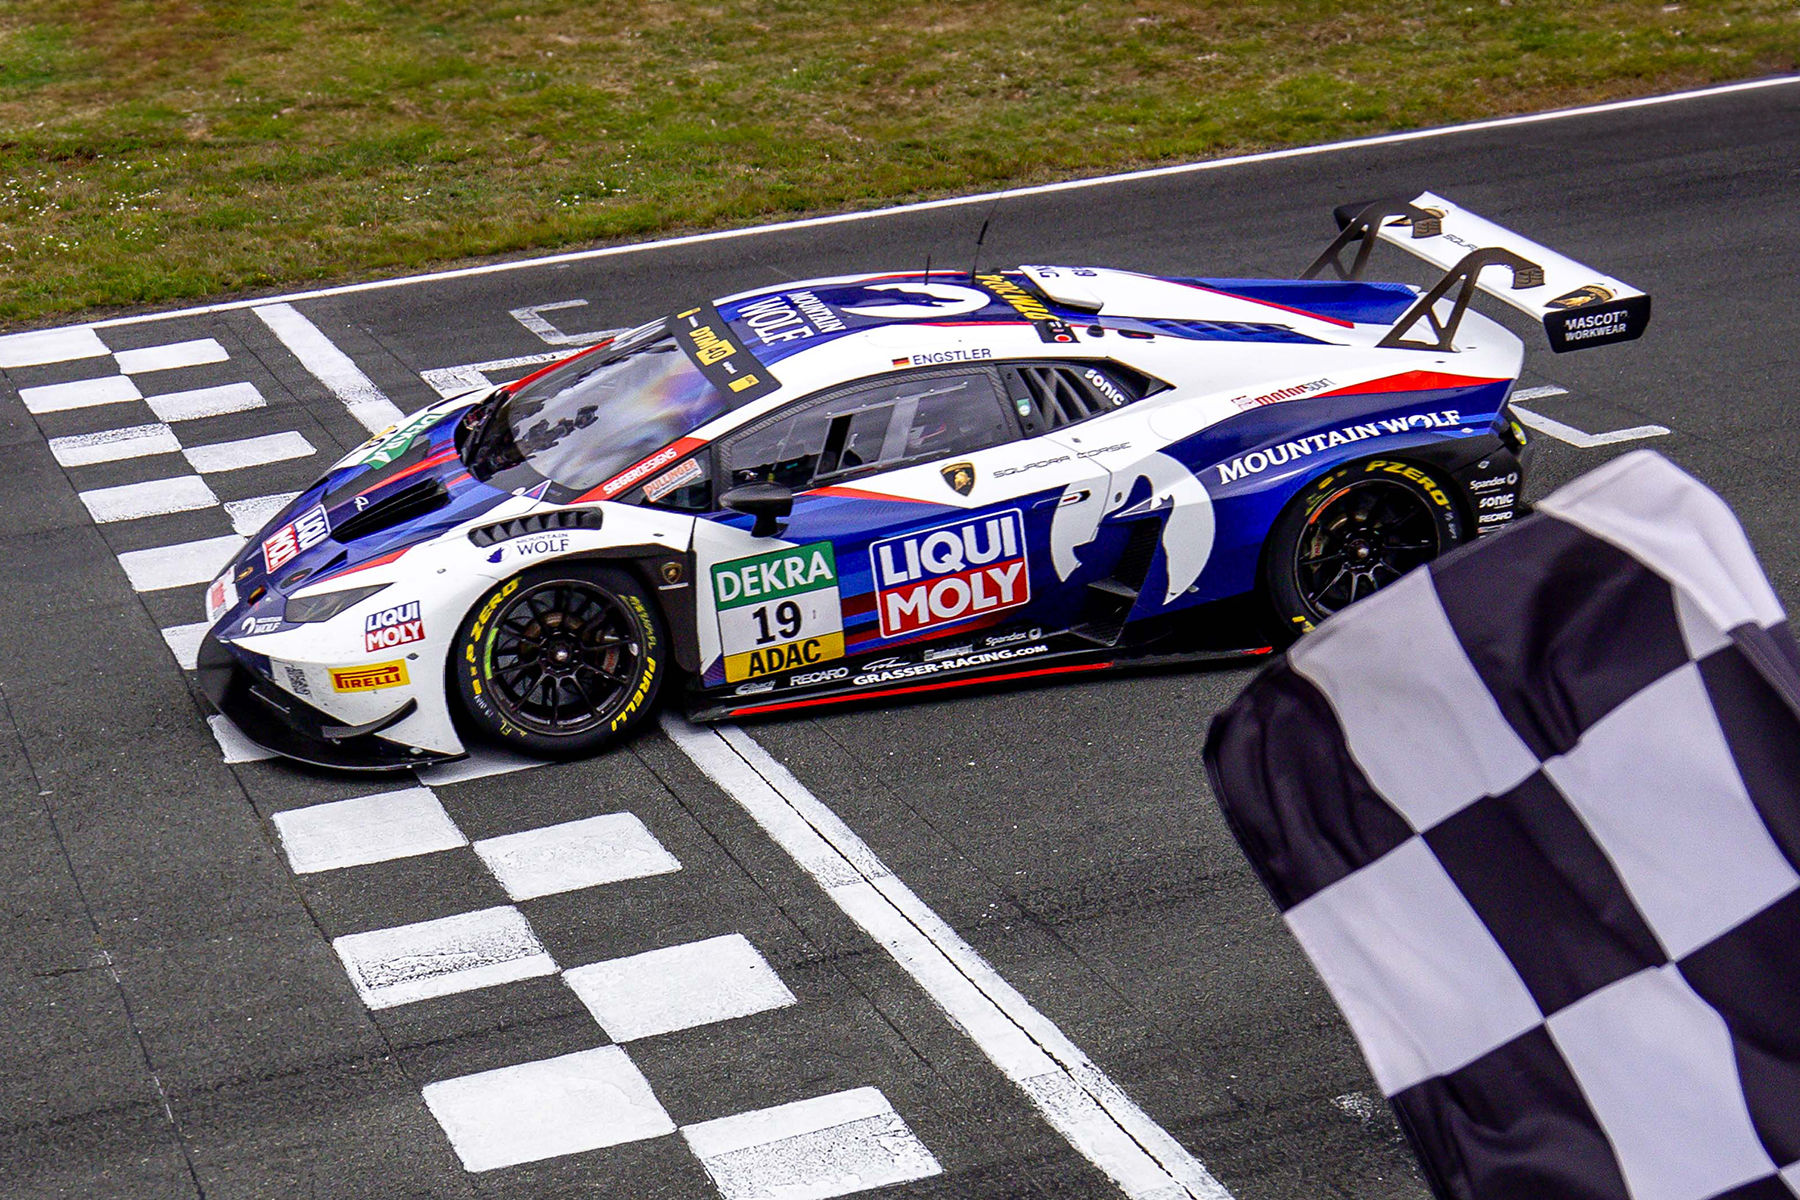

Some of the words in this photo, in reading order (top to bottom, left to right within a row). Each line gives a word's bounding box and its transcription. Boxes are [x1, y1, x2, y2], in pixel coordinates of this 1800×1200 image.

[737, 296, 815, 346] WOLF
[787, 290, 847, 333] MOUNTAIN
[1565, 311, 1620, 330] MASCOT
[689, 325, 721, 350] DTM
[1565, 323, 1627, 341] WORKWEAR
[913, 348, 992, 366] ENGSTLER
[993, 454, 1071, 479] SQUADRA
[1076, 442, 1132, 460] CORSE
[1216, 423, 1385, 486] MOUNTAIN
[1380, 410, 1460, 434] WOLF
[602, 447, 677, 495] SIEGERDESIGNS
[1470, 476, 1506, 490] Spandex
[1479, 511, 1513, 523] RECARO
[517, 539, 570, 556] WOLF
[879, 515, 1018, 586] LIQUI
[715, 551, 834, 602] DEKRA
[886, 561, 1025, 632] MOLY
[367, 600, 420, 632] LIQUI
[752, 600, 802, 646] 19
[367, 622, 424, 652] MOLY
[985, 630, 1027, 647] Spandex
[748, 639, 821, 678] ADAC
[333, 665, 402, 689] PIRELLI
[789, 667, 849, 687] RECARO
[611, 656, 657, 732] PIRELLI
